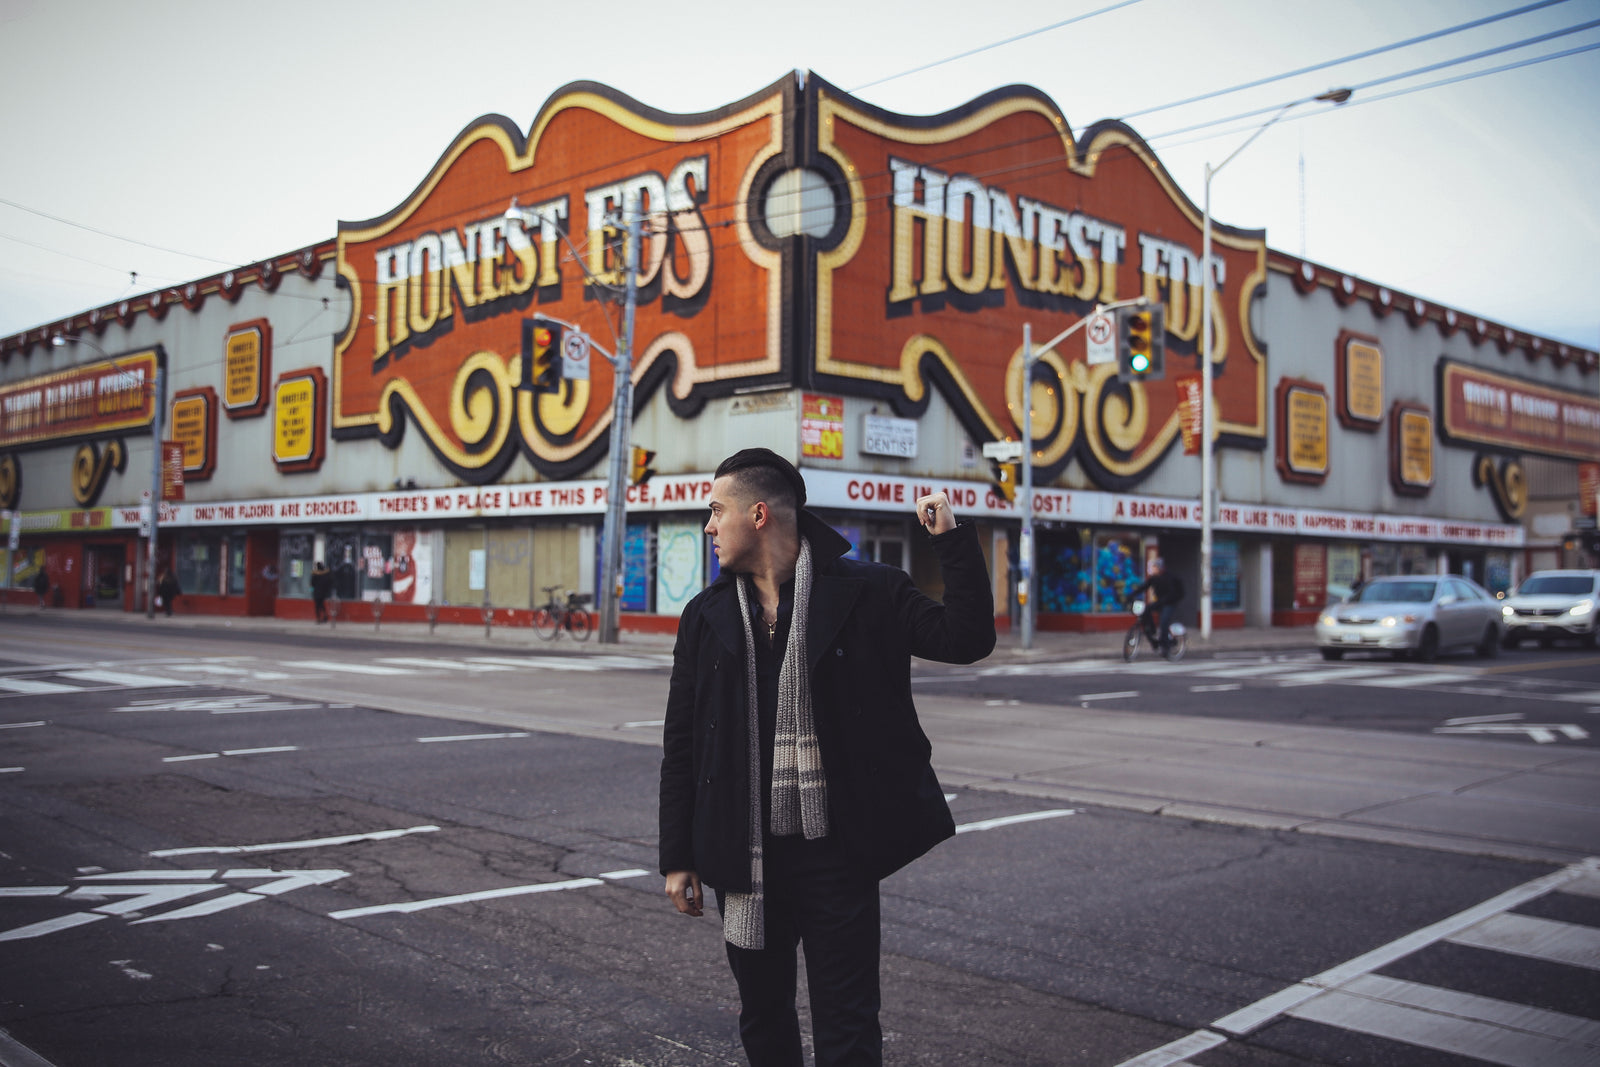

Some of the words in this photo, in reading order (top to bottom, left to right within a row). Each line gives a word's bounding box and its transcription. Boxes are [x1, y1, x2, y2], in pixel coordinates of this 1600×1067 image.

[888, 156, 1127, 305] HONEST
[373, 196, 569, 361] HONEST
[867, 437, 915, 454] DENTIST
[219, 506, 235, 520] THE
[280, 502, 300, 517] ARE
[379, 496, 428, 513] THERE'S
[435, 494, 450, 510] NO
[457, 492, 502, 509] PLACE
[510, 490, 542, 507] LIKE
[550, 488, 585, 506] THIS
[662, 481, 712, 502] ANYP
[847, 480, 904, 503] COME
[1030, 493, 1071, 513] OST!
[1115, 501, 1125, 517] A
[1130, 502, 1188, 521] BARGAIN
[1193, 507, 1238, 525] CTRE
[1273, 511, 1296, 528] THIS
[1303, 516, 1346, 530] HAPPENS
